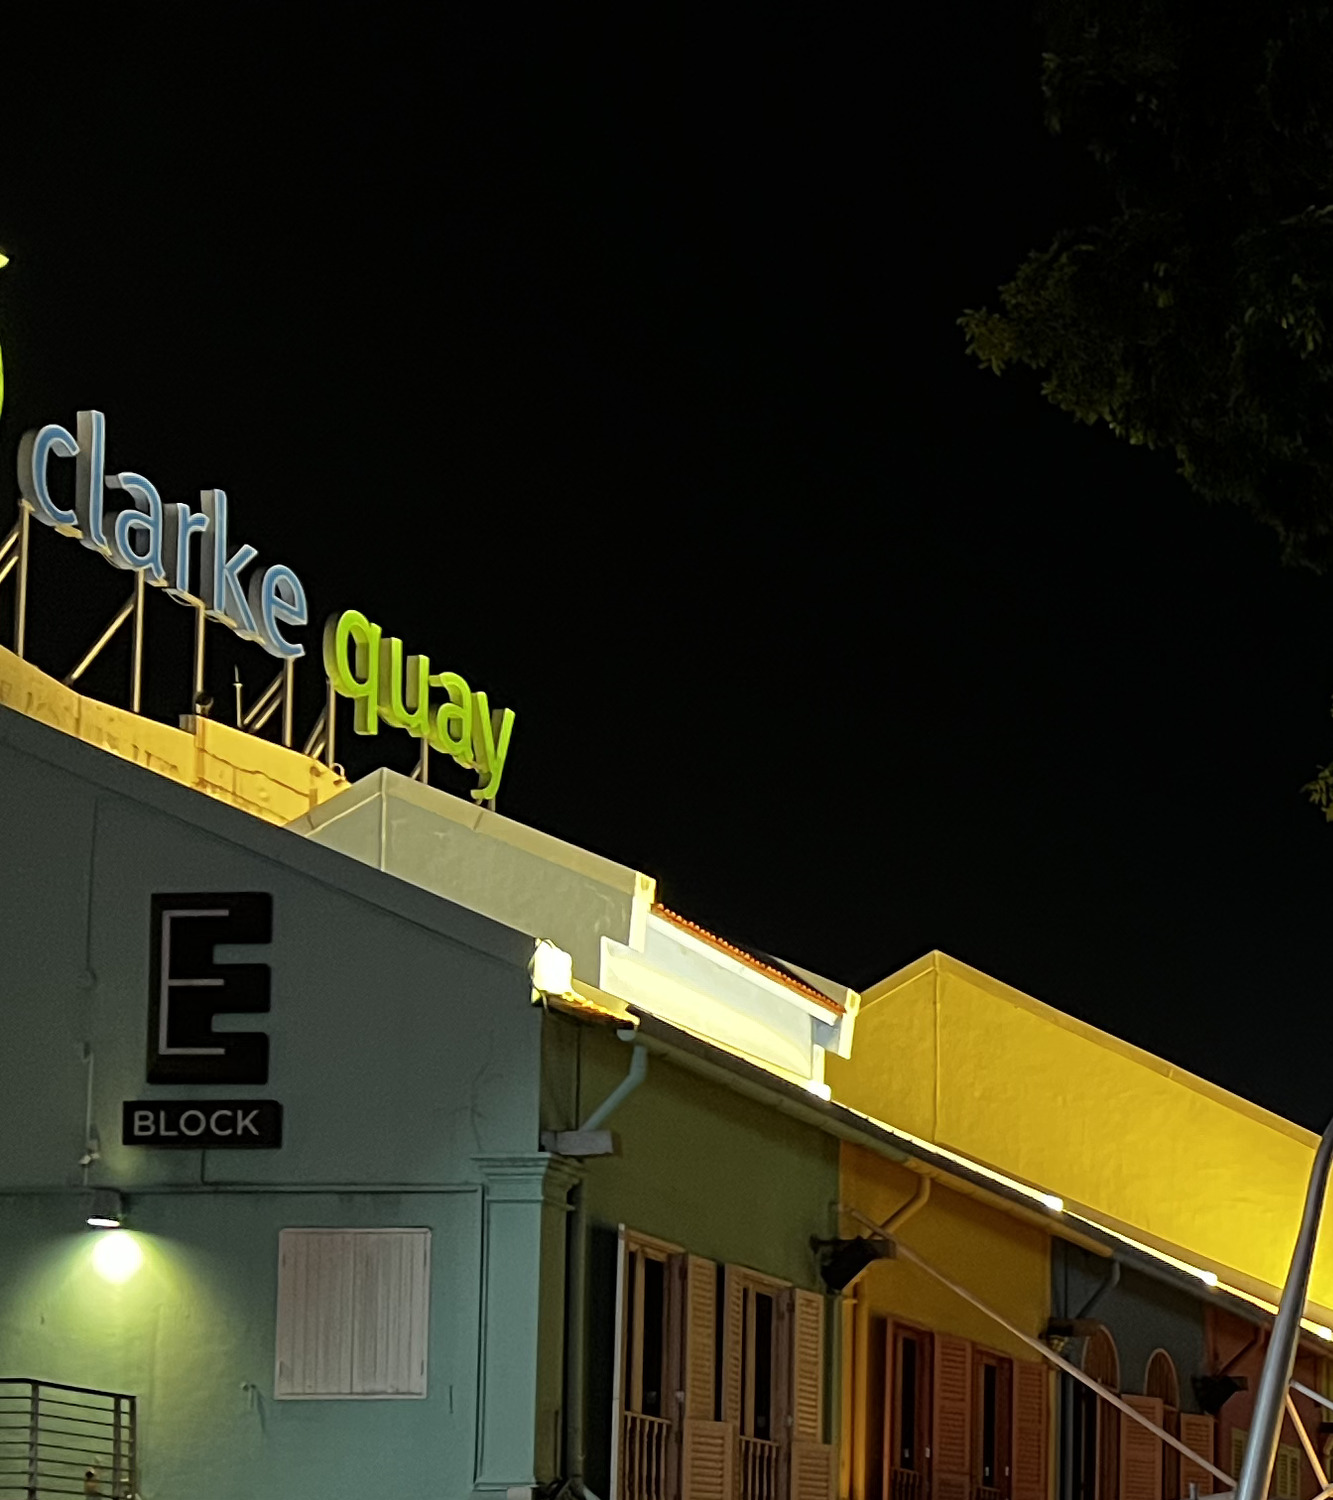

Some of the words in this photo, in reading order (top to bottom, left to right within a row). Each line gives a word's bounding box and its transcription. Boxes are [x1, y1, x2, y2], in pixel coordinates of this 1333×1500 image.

[18, 410, 308, 658] clarke
[323, 609, 515, 801] quay
[147, 892, 273, 1085] E
[133, 1110, 260, 1136] BLOCK
